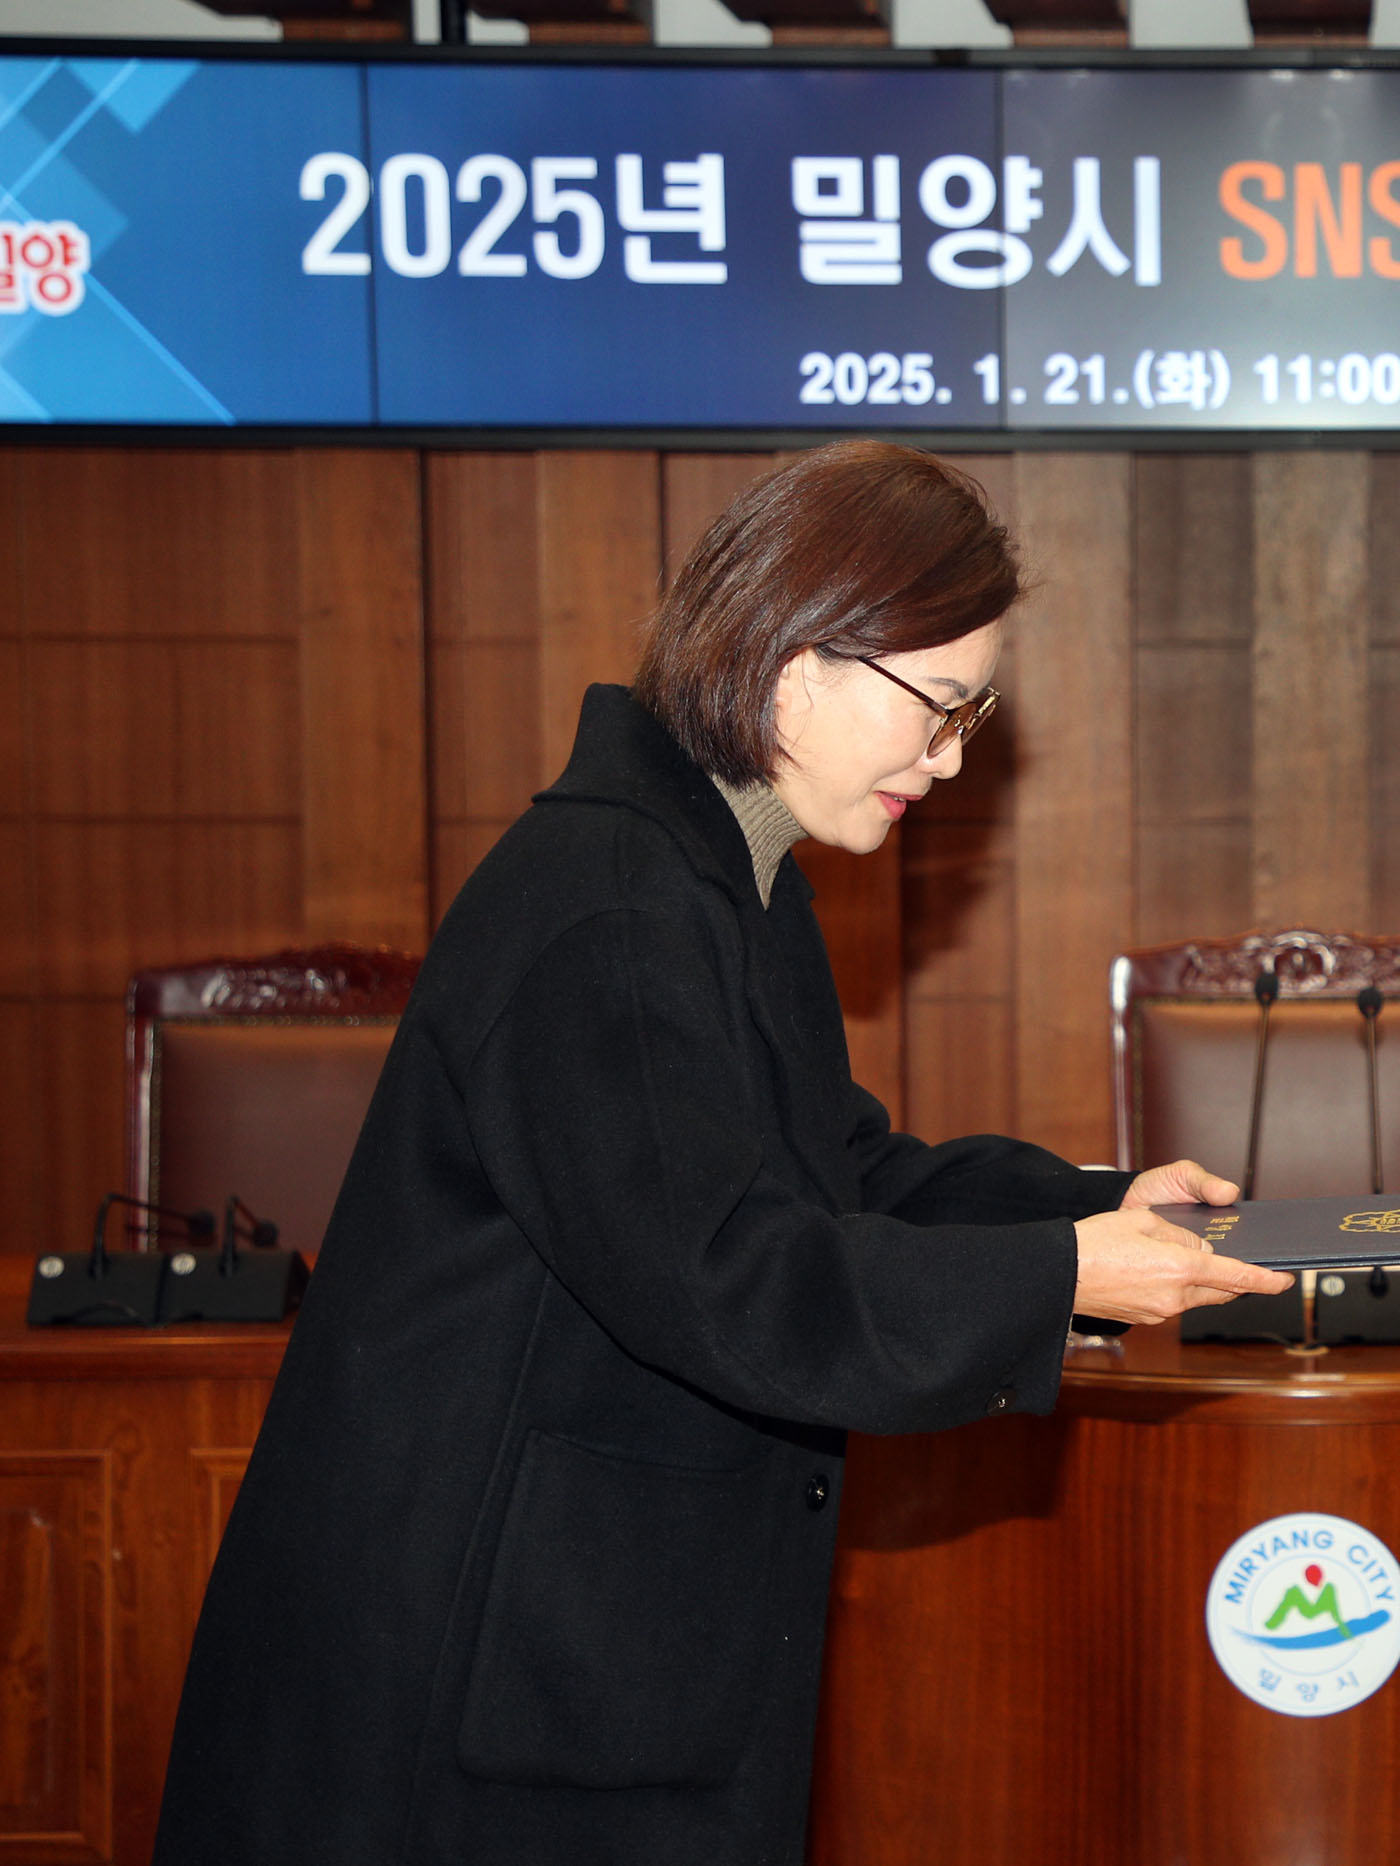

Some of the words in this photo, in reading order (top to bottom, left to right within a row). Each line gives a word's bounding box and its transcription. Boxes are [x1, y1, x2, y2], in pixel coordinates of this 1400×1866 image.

[300, 152, 728, 284] 2025년
[791, 154, 1161, 290] 밀양시
[799, 351, 953, 405] 2025.
[1224, 1529, 1335, 1605] MIRYANG
[1348, 1544, 1396, 1602] CITY
